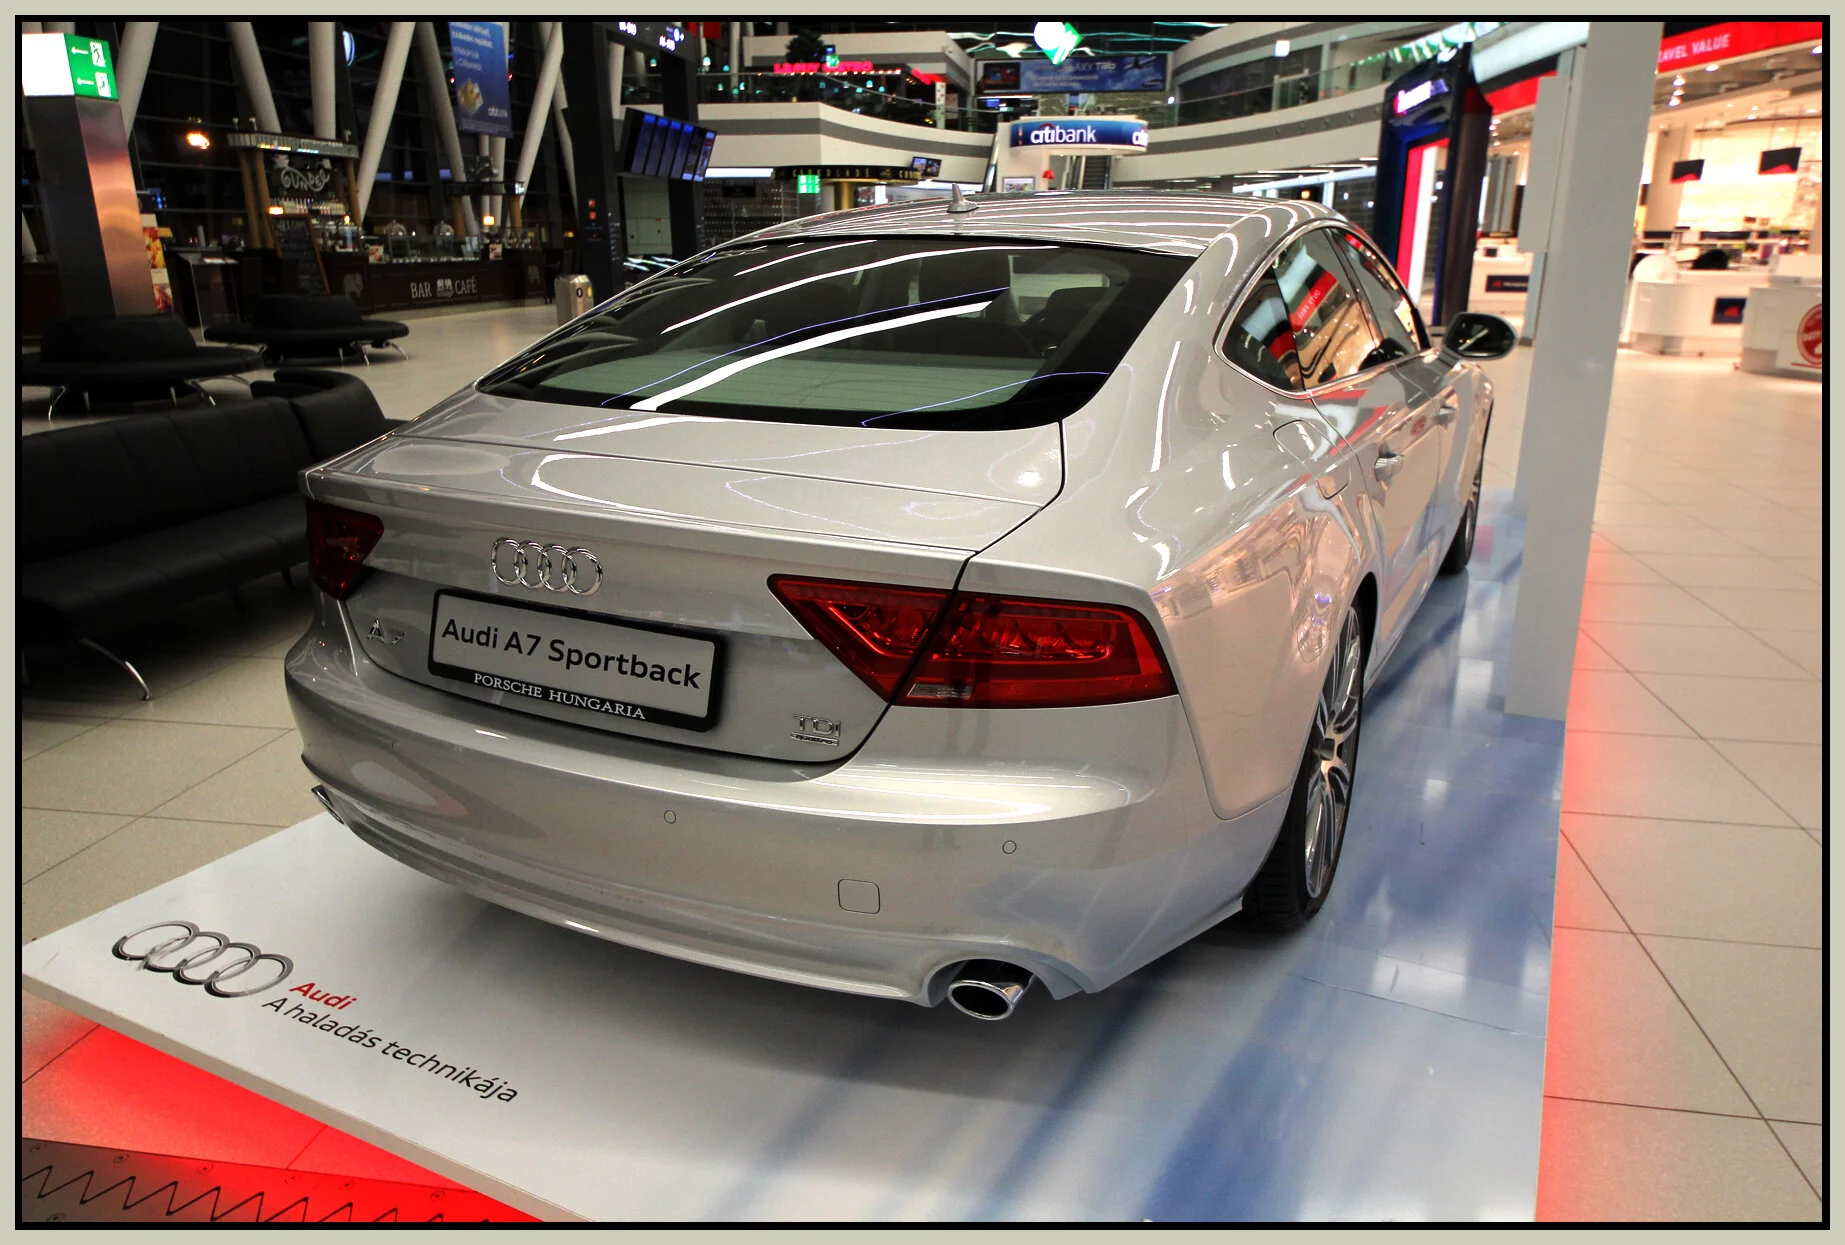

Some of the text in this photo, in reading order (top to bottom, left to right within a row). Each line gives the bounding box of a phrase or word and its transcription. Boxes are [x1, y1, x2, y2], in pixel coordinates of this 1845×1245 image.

[1692, 33, 1731, 55] VALUE
[1030, 123, 1097, 144] citibank
[410, 275, 478, 299] BAR CAFÉ
[441, 618, 702, 689] Audi A7 Sportback
[474, 672, 646, 720] PORSCHE HUNGARIA
[793, 714, 841, 737] TDI
[289, 982, 358, 1011] Audi
[261, 997, 518, 1103] A haladás technikája
